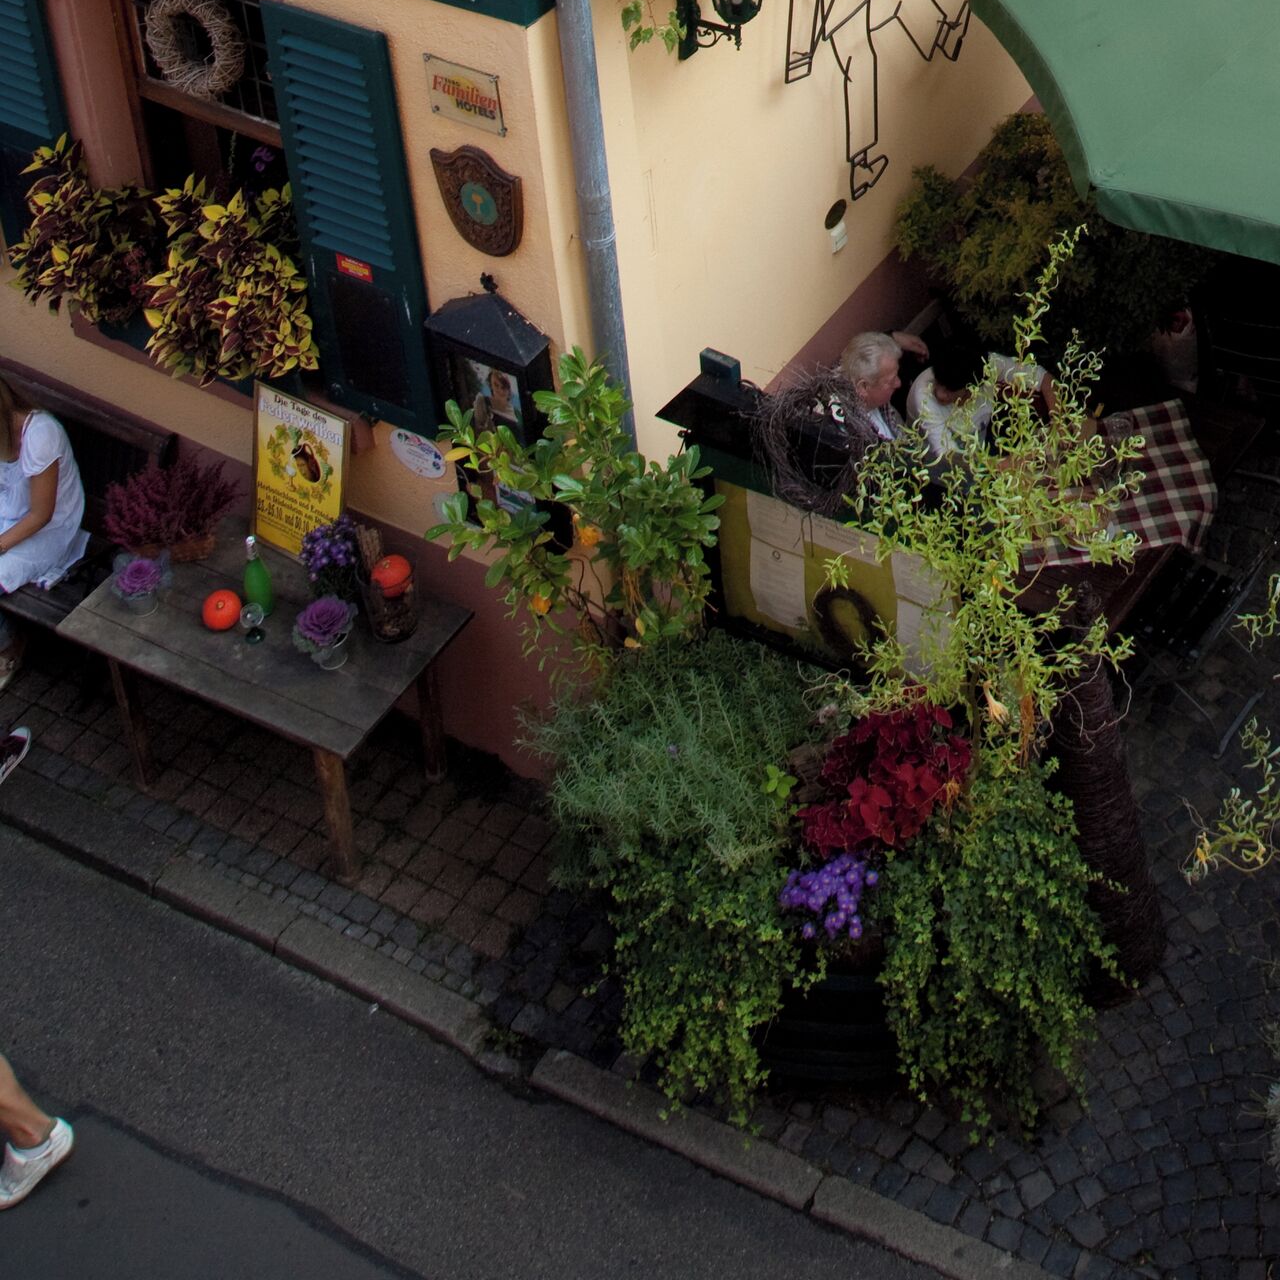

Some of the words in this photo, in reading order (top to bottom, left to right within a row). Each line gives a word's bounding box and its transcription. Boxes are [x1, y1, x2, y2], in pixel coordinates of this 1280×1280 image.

[432, 74, 497, 111] Familien
[455, 99, 497, 121] HOTELS
[274, 394, 288, 407] Die
[290, 400, 311, 418] Tage
[312, 412, 327, 424] des
